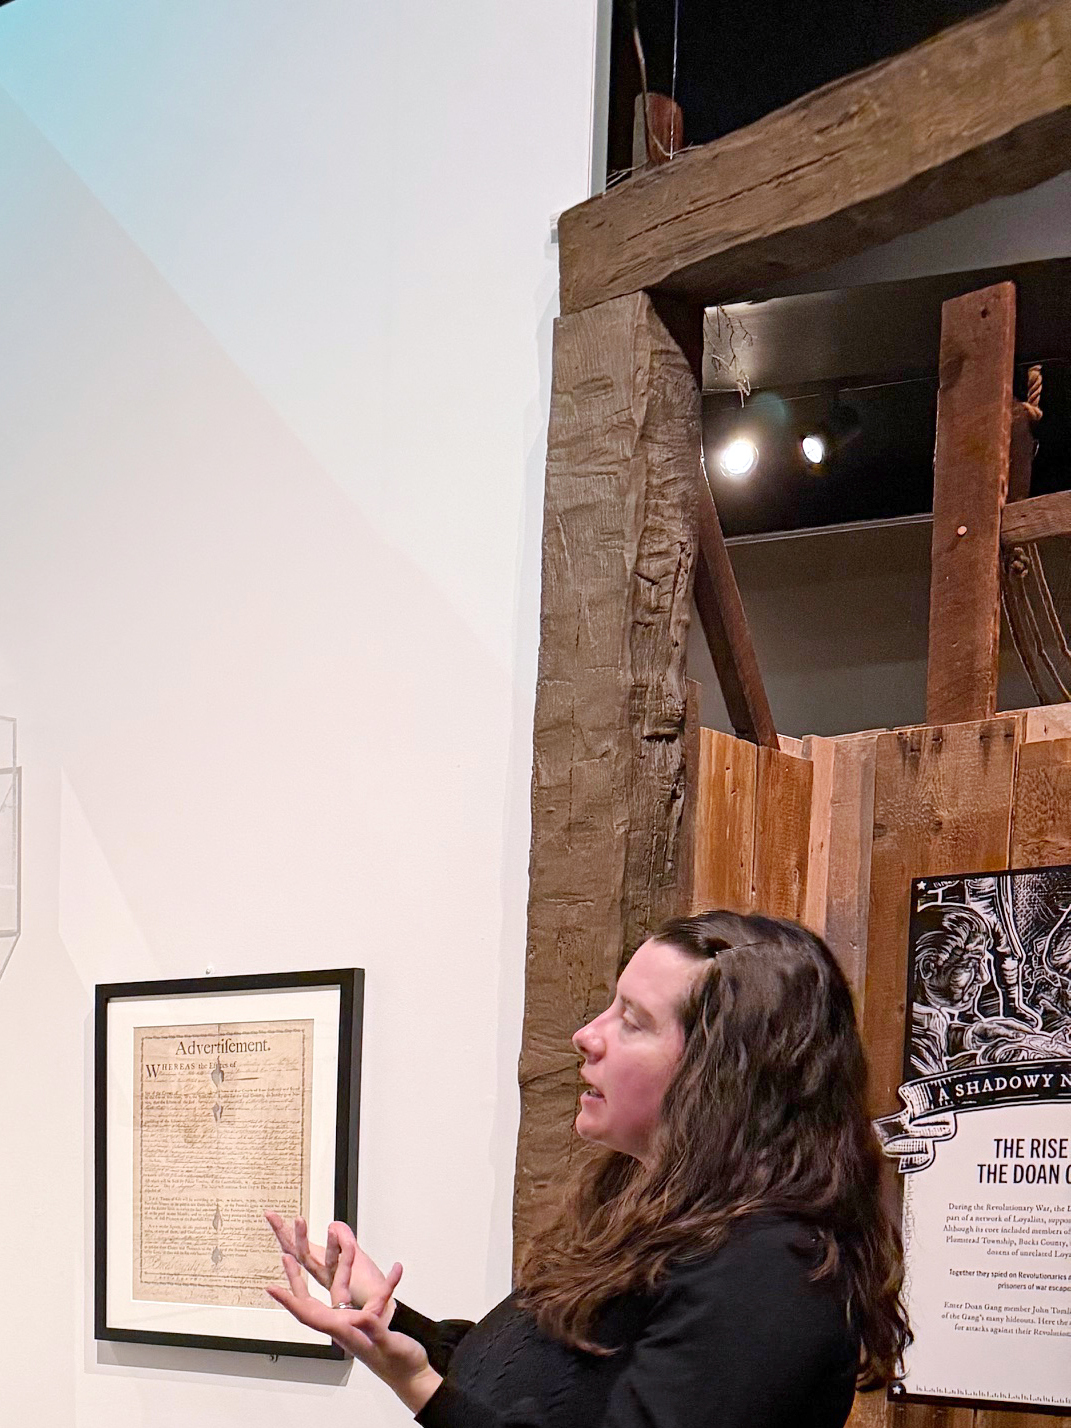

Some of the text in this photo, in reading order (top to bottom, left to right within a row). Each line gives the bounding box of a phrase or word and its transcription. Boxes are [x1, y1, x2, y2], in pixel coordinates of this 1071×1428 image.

[146, 1062, 196, 1078] WHEREAS
[938, 1087, 950, 1103] A
[955, 1073, 1055, 1097] SHADOWY
[994, 1138, 1069, 1159] THE RISE
[977, 1164, 1008, 1184] THE
[1013, 1164, 1060, 1184] DOAN
